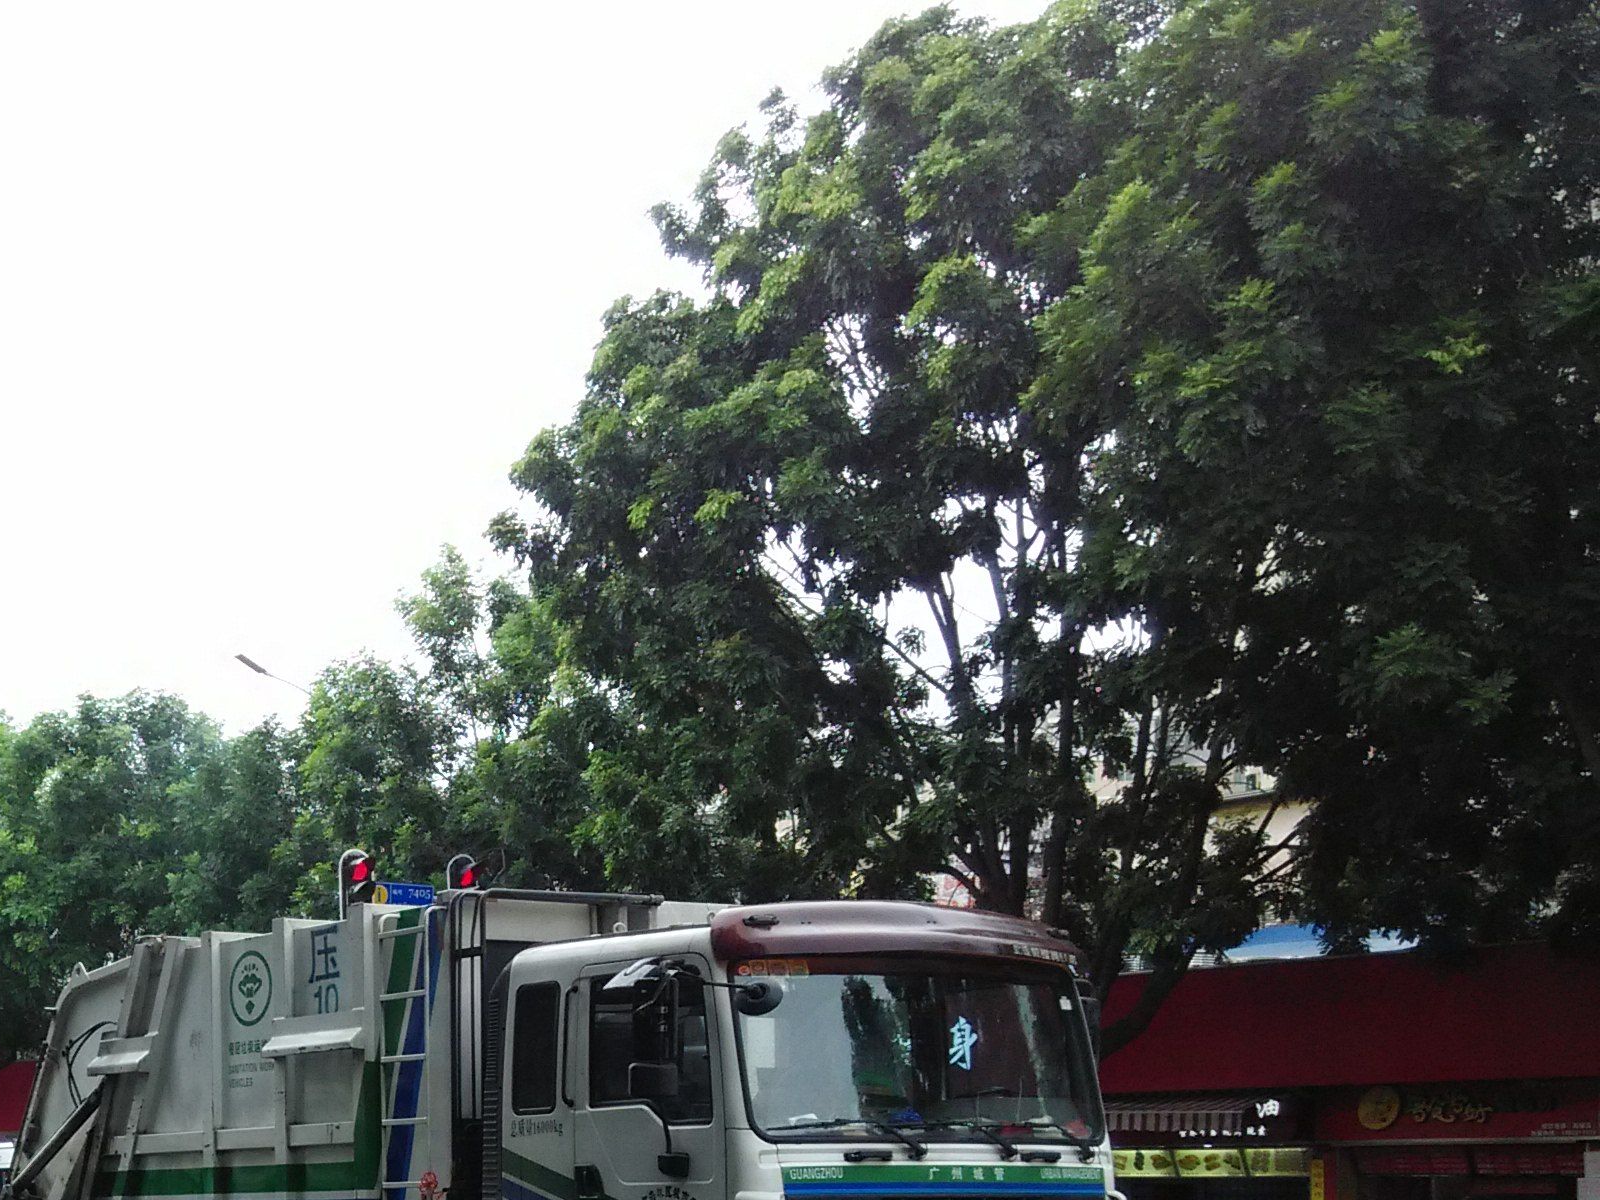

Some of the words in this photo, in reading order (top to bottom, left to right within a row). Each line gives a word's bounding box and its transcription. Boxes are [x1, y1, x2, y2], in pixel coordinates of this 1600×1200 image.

[409, 888, 431, 900] 7405
[308, 925, 340, 984] 压
[314, 983, 339, 1015] 10
[789, 1167, 844, 1180] GUANGZHOU
[1040, 1168, 1062, 1179] URBAN
[1063, 1168, 1101, 1180] MANAGEMENT
